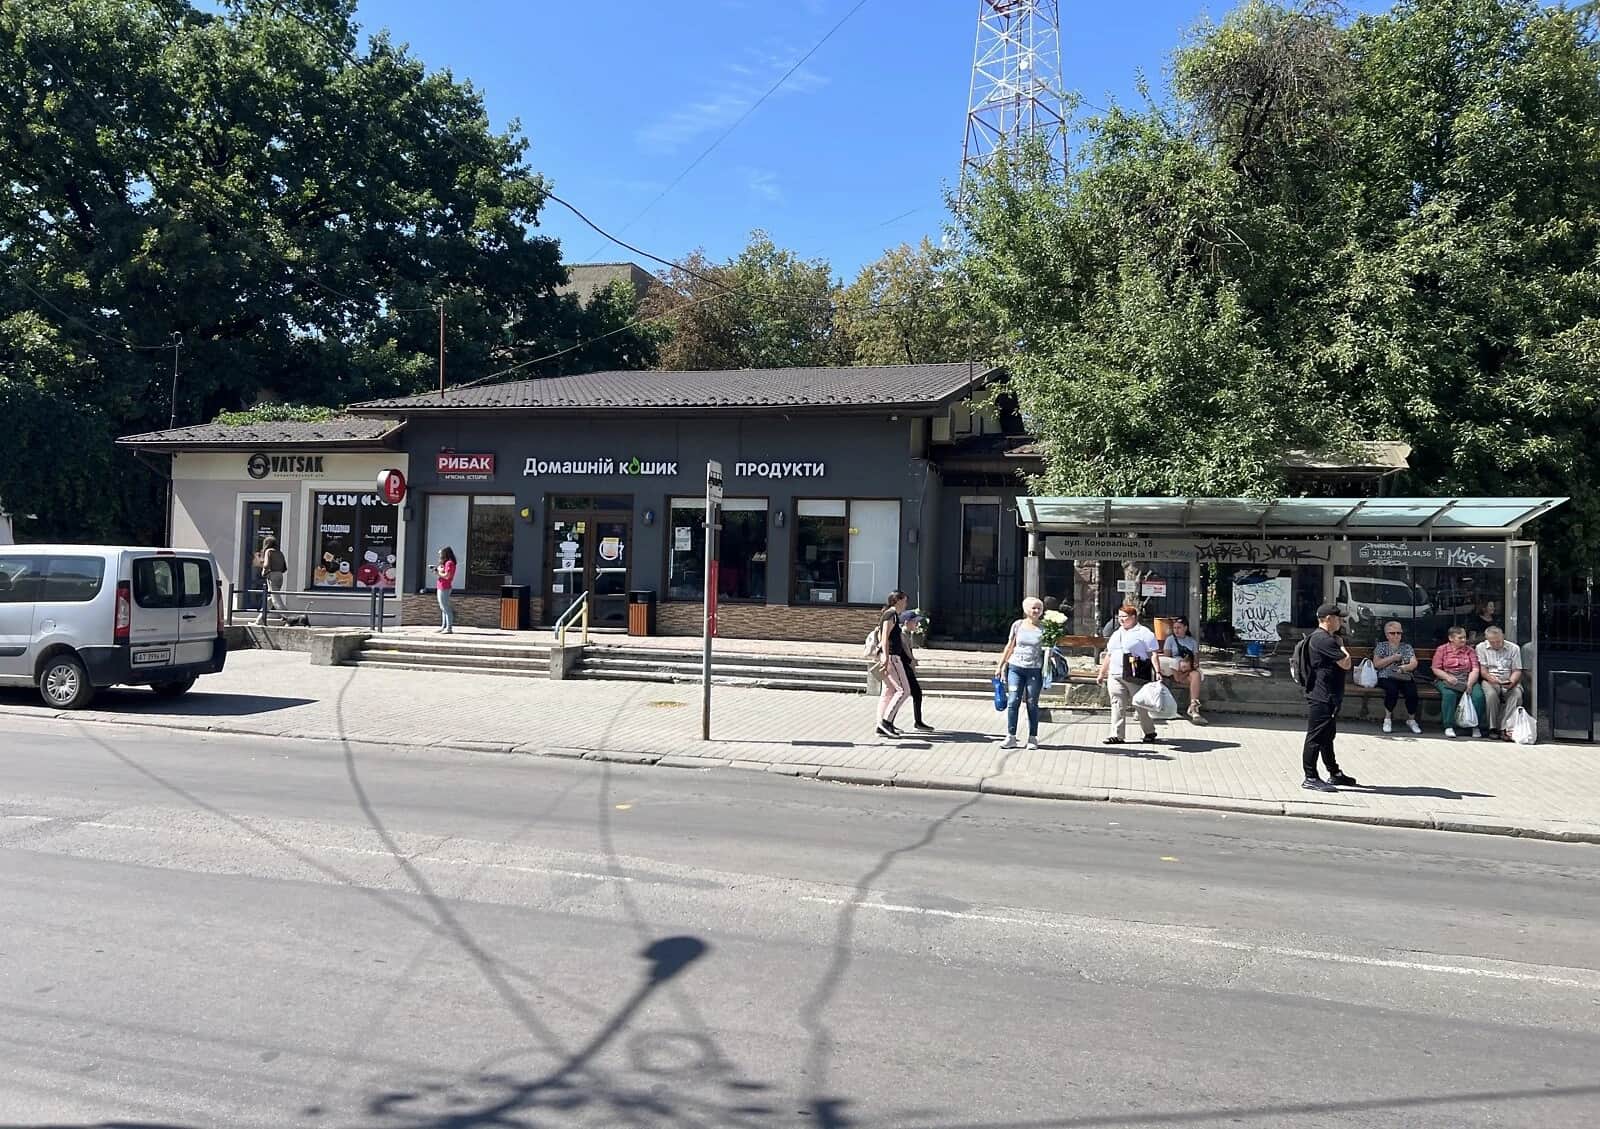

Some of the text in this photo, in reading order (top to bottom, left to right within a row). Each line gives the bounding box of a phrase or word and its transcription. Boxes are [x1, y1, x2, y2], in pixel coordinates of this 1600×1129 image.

[271, 456, 324, 473] VATSAK
[438, 457, 490, 470] РИБАК
[523, 456, 678, 477] Домашній кошик
[735, 462, 825, 479] ПРОДУКТИ
